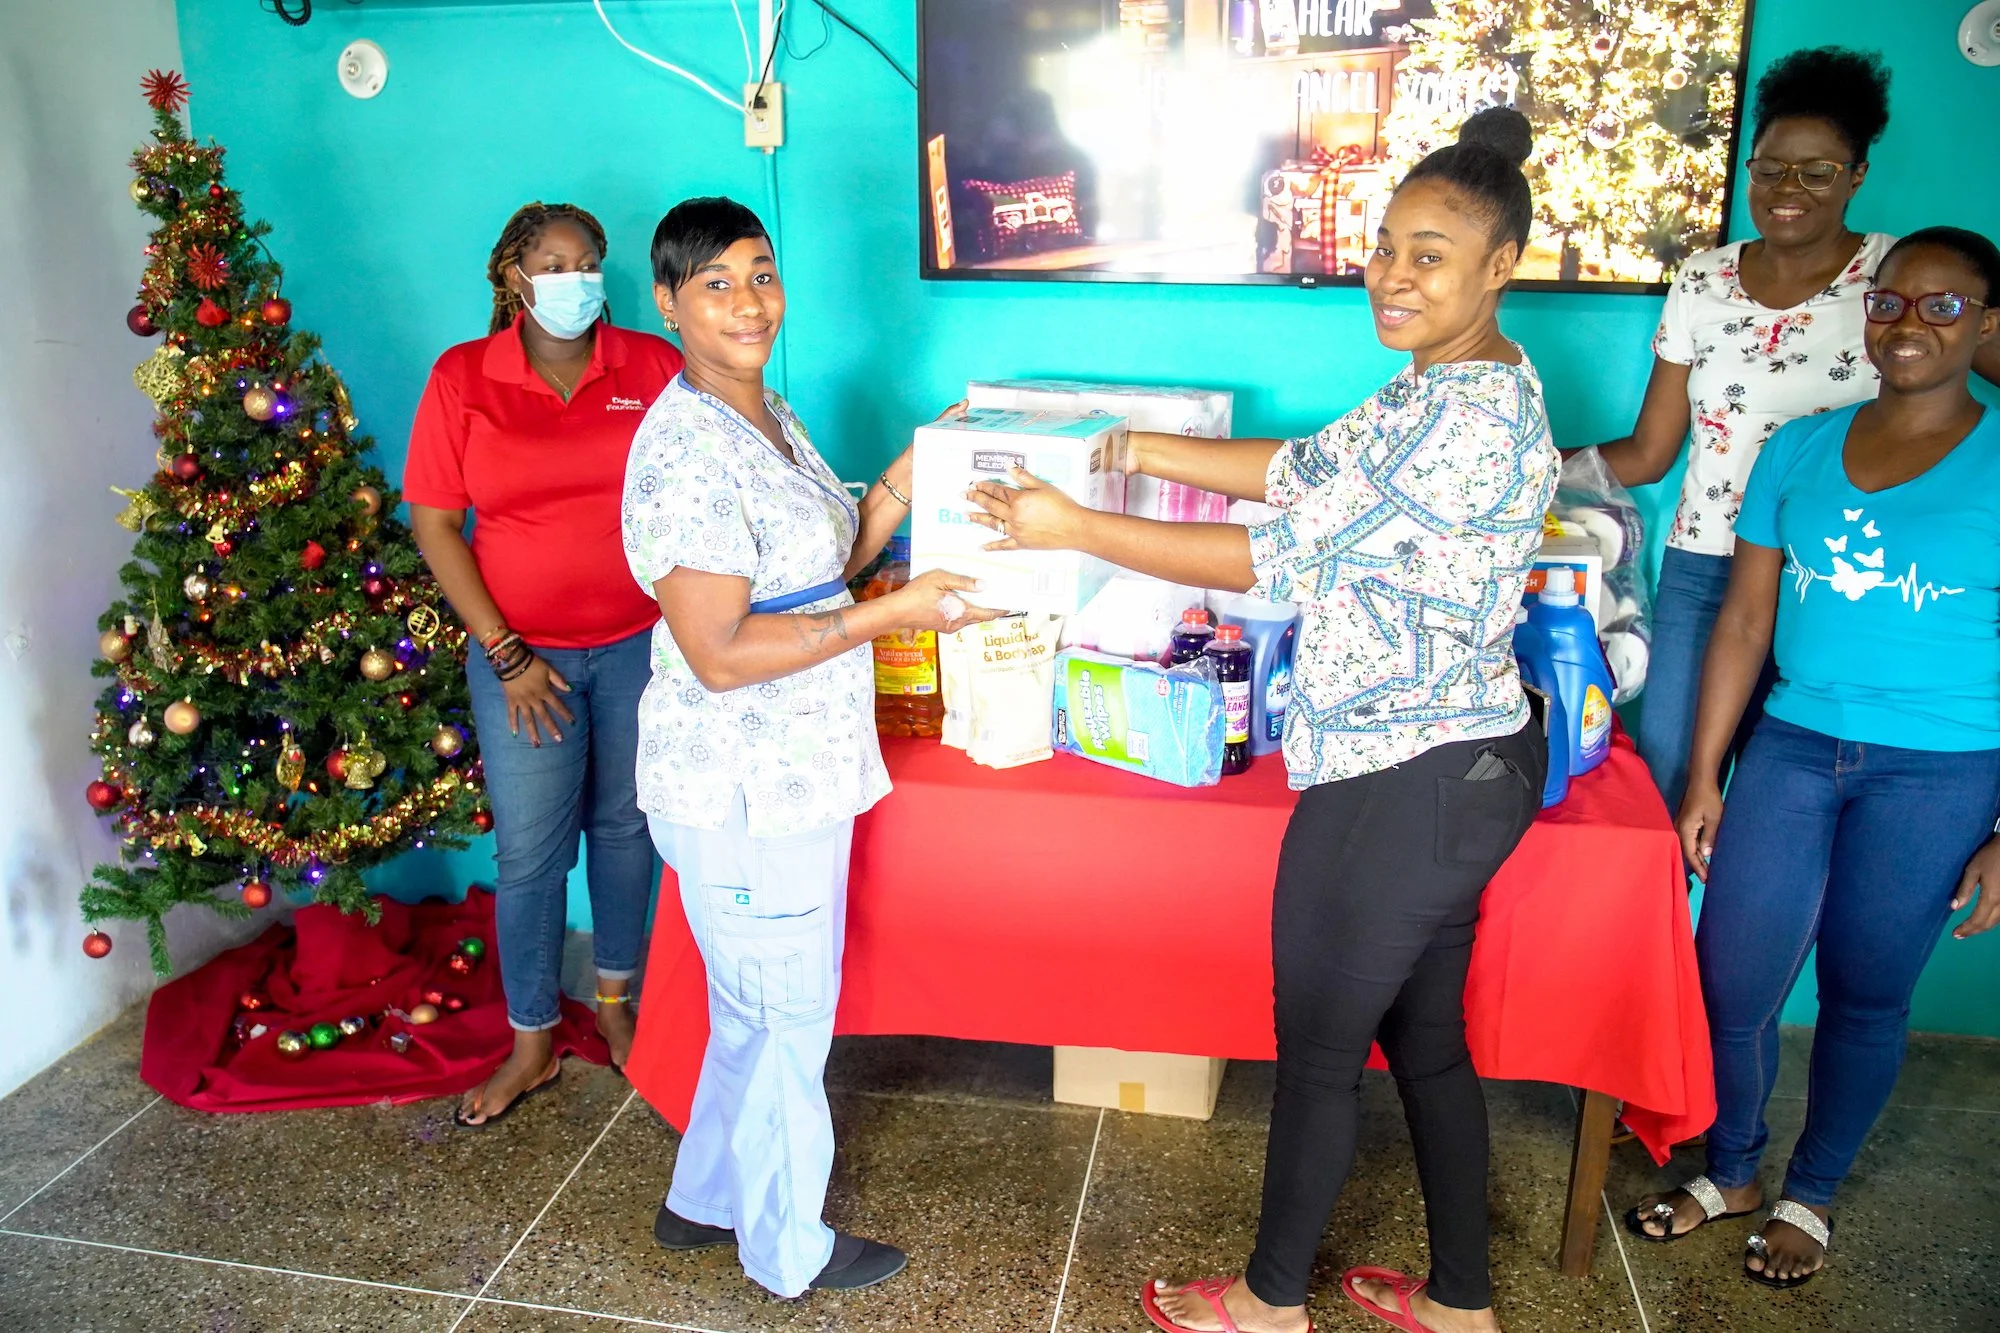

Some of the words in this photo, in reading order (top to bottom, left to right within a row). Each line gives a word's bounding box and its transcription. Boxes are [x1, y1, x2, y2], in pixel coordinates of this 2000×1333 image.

[1298, 0, 1374, 37] HEAR
[1293, 71, 1380, 115] ANGEL
[983, 651, 993, 663] &
[984, 632, 1024, 648] Liquid
[1079, 669, 1107, 751] Reusable
[1093, 684, 1111, 740] Wipes
